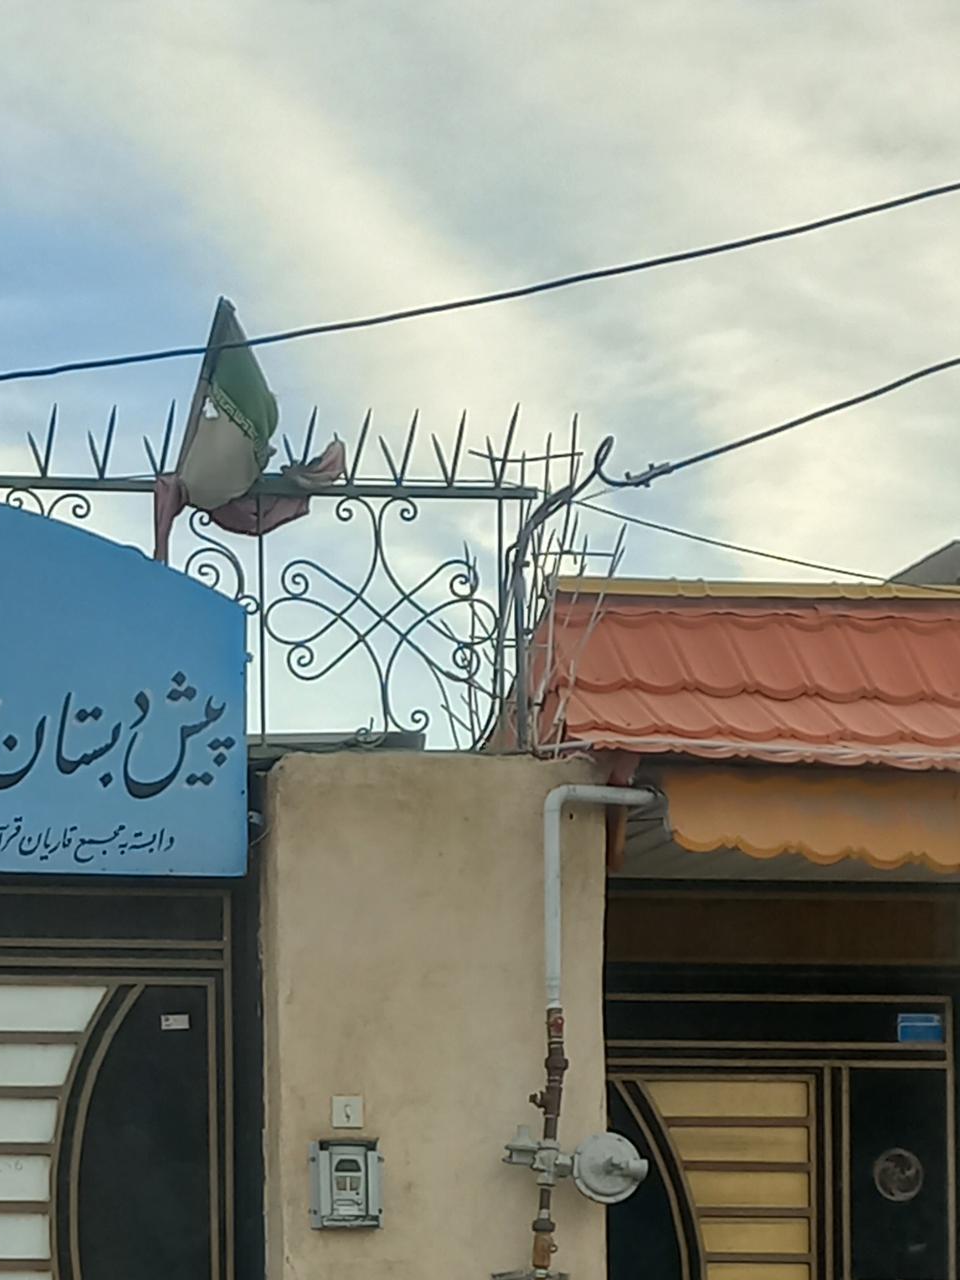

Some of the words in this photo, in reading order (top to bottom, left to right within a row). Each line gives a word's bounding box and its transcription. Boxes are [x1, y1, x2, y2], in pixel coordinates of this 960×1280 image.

[123, 670, 236, 799] پیش
[19, 826, 78, 861] قاریان
[73, 824, 126, 863] مجمع
[128, 828, 175, 853] وابسته
